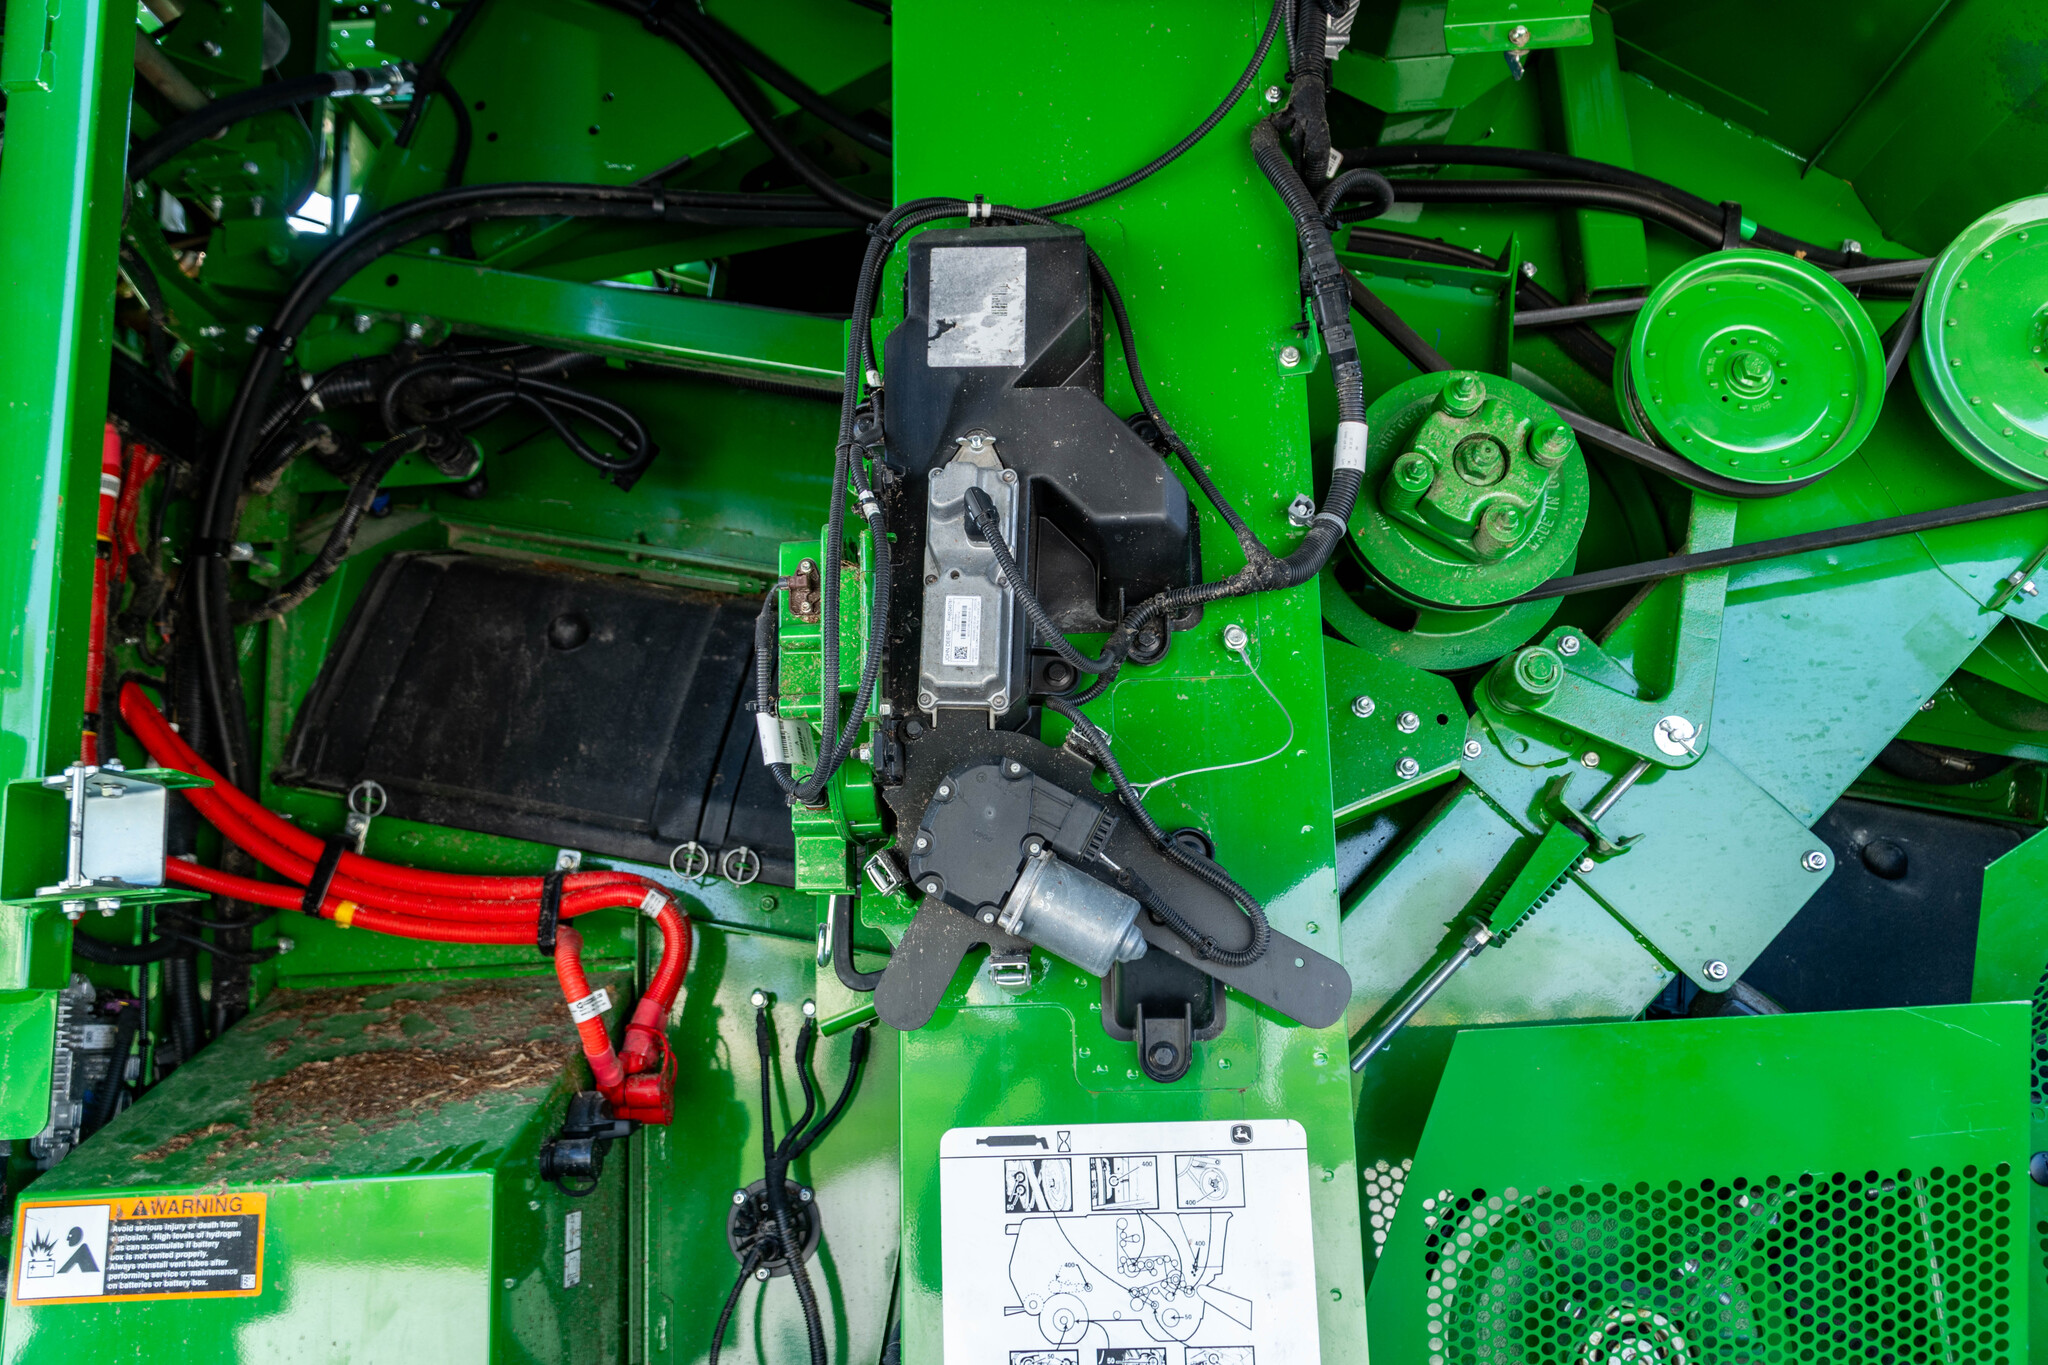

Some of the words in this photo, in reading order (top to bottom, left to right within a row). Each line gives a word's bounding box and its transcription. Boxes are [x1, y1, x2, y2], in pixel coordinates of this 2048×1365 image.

[1526, 516, 1555, 551] MADE
[1546, 496, 1560, 511] IN
[151, 1196, 242, 1215] WARNING
[1006, 1204, 1015, 1212] 50
[164, 1223, 186, 1232] injury
[198, 1221, 219, 1229] death
[152, 1232, 171, 1241] High
[172, 1231, 194, 1239] levels
[196, 1230, 205, 1238] of
[205, 1230, 242, 1239] hydrogen
[141, 1242, 184, 1250] accumulate
[192, 1240, 220, 1249] battery
[148, 1251, 174, 1259] vented
[175, 1250, 208, 1259] properly.
[109, 1262, 136, 1271] Always
[137, 1261, 168, 1269] reinstall
[108, 1272, 150, 1281] performing
[151, 1270, 179, 1278] service
[190, 1268, 238, 1276] maintenance
[119, 1281, 152, 1289] batteries
[163, 1279, 190, 1288] battery
